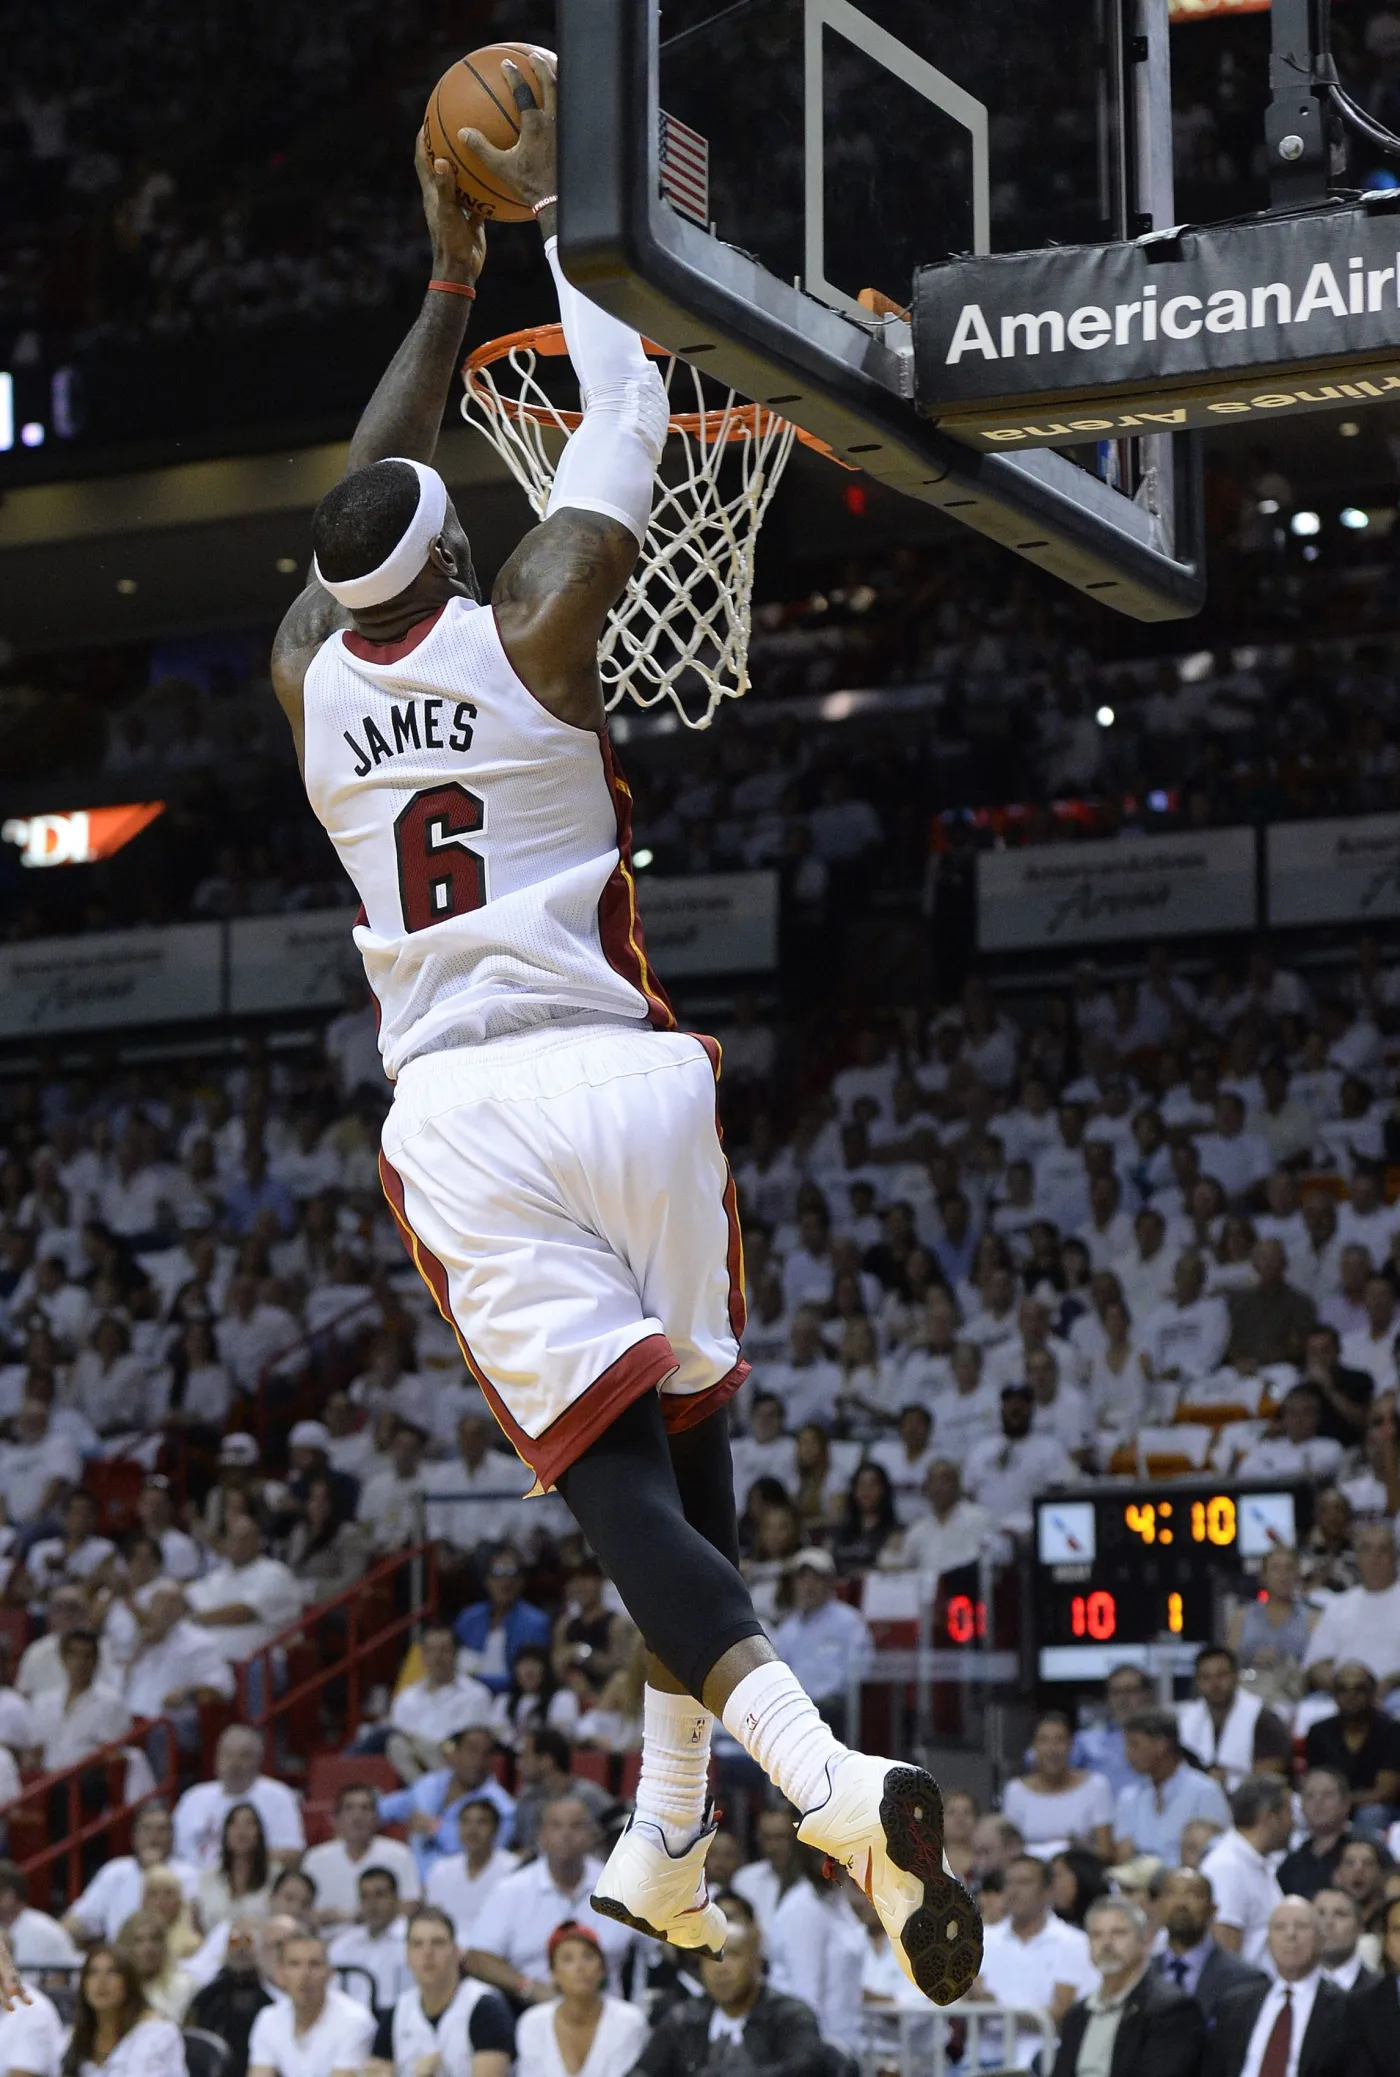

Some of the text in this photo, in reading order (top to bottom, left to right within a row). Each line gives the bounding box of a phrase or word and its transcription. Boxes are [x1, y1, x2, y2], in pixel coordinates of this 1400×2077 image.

[945, 251, 1400, 366] AmericanAir
[979, 408, 1187, 441] Arena
[343, 699, 478, 777] JAMES
[393, 780, 488, 934] 6
[1125, 1496, 1236, 1546] 4:10
[1072, 1590, 1183, 1640] 10 1
